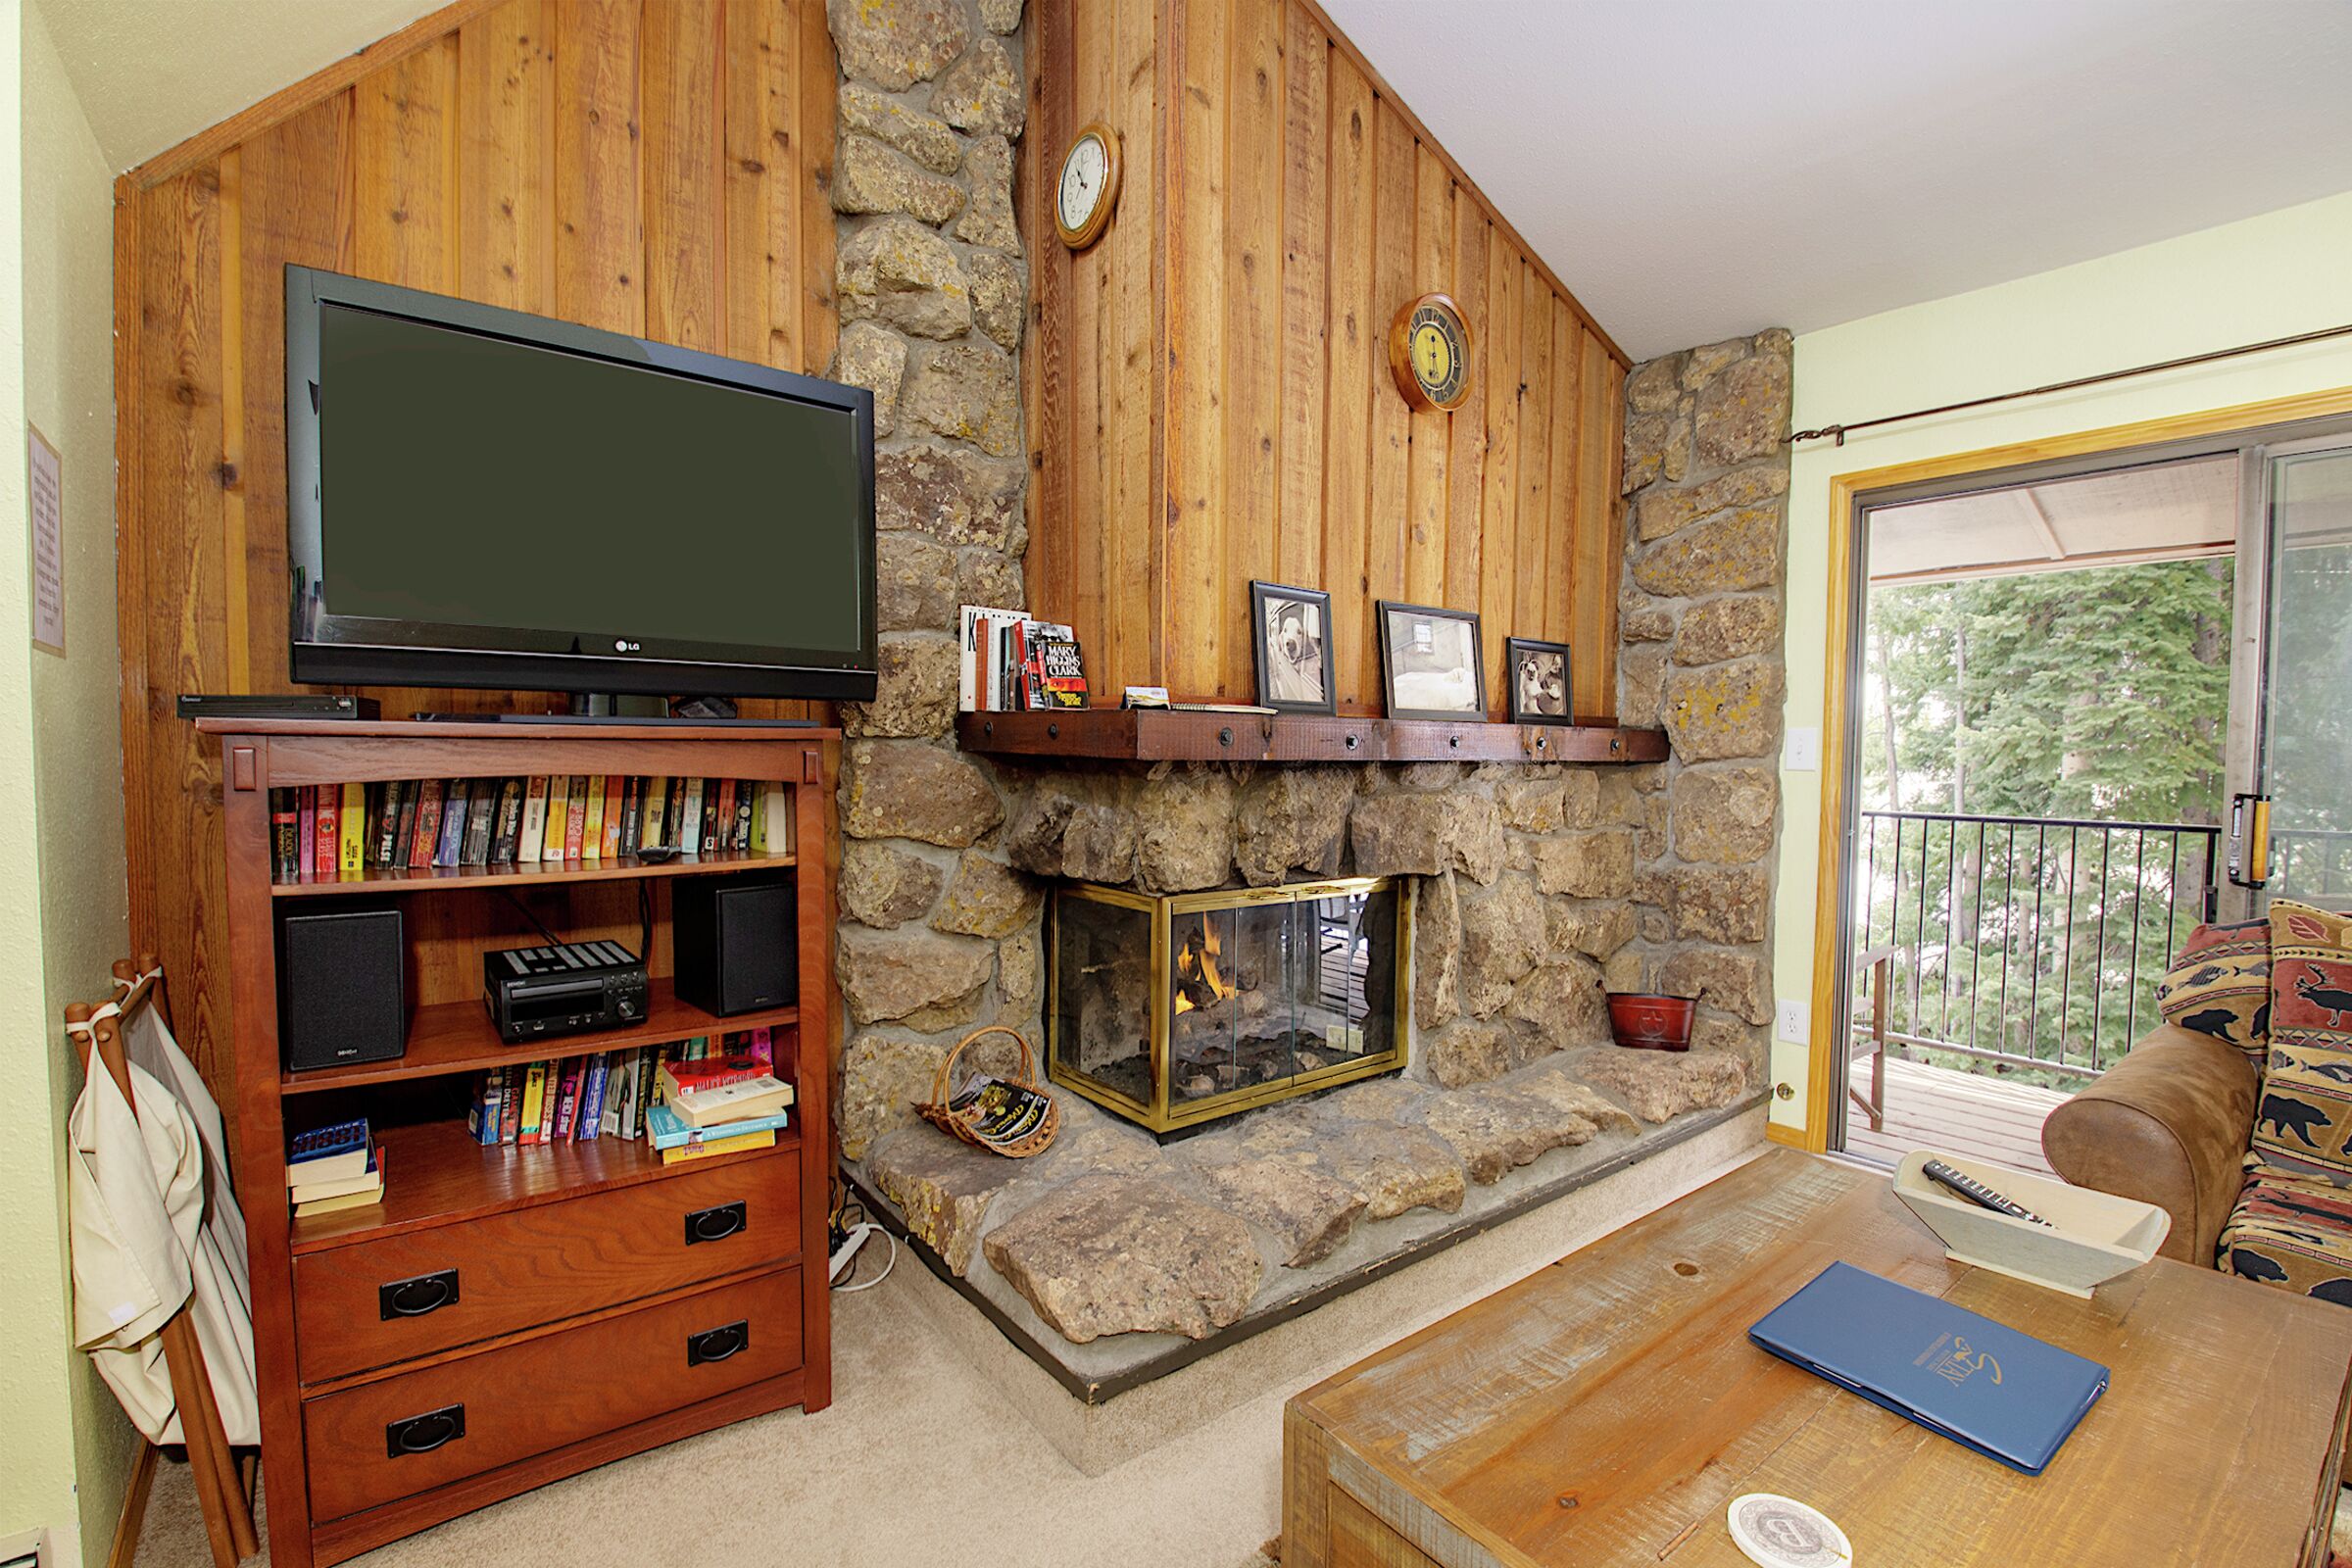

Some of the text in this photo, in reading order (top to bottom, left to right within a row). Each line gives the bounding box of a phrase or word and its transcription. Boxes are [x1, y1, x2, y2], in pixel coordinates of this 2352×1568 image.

[1049, 646, 1076, 657] MARY
[1046, 656, 1080, 666] HIGGINS
[1049, 665, 1082, 676] CLARK
